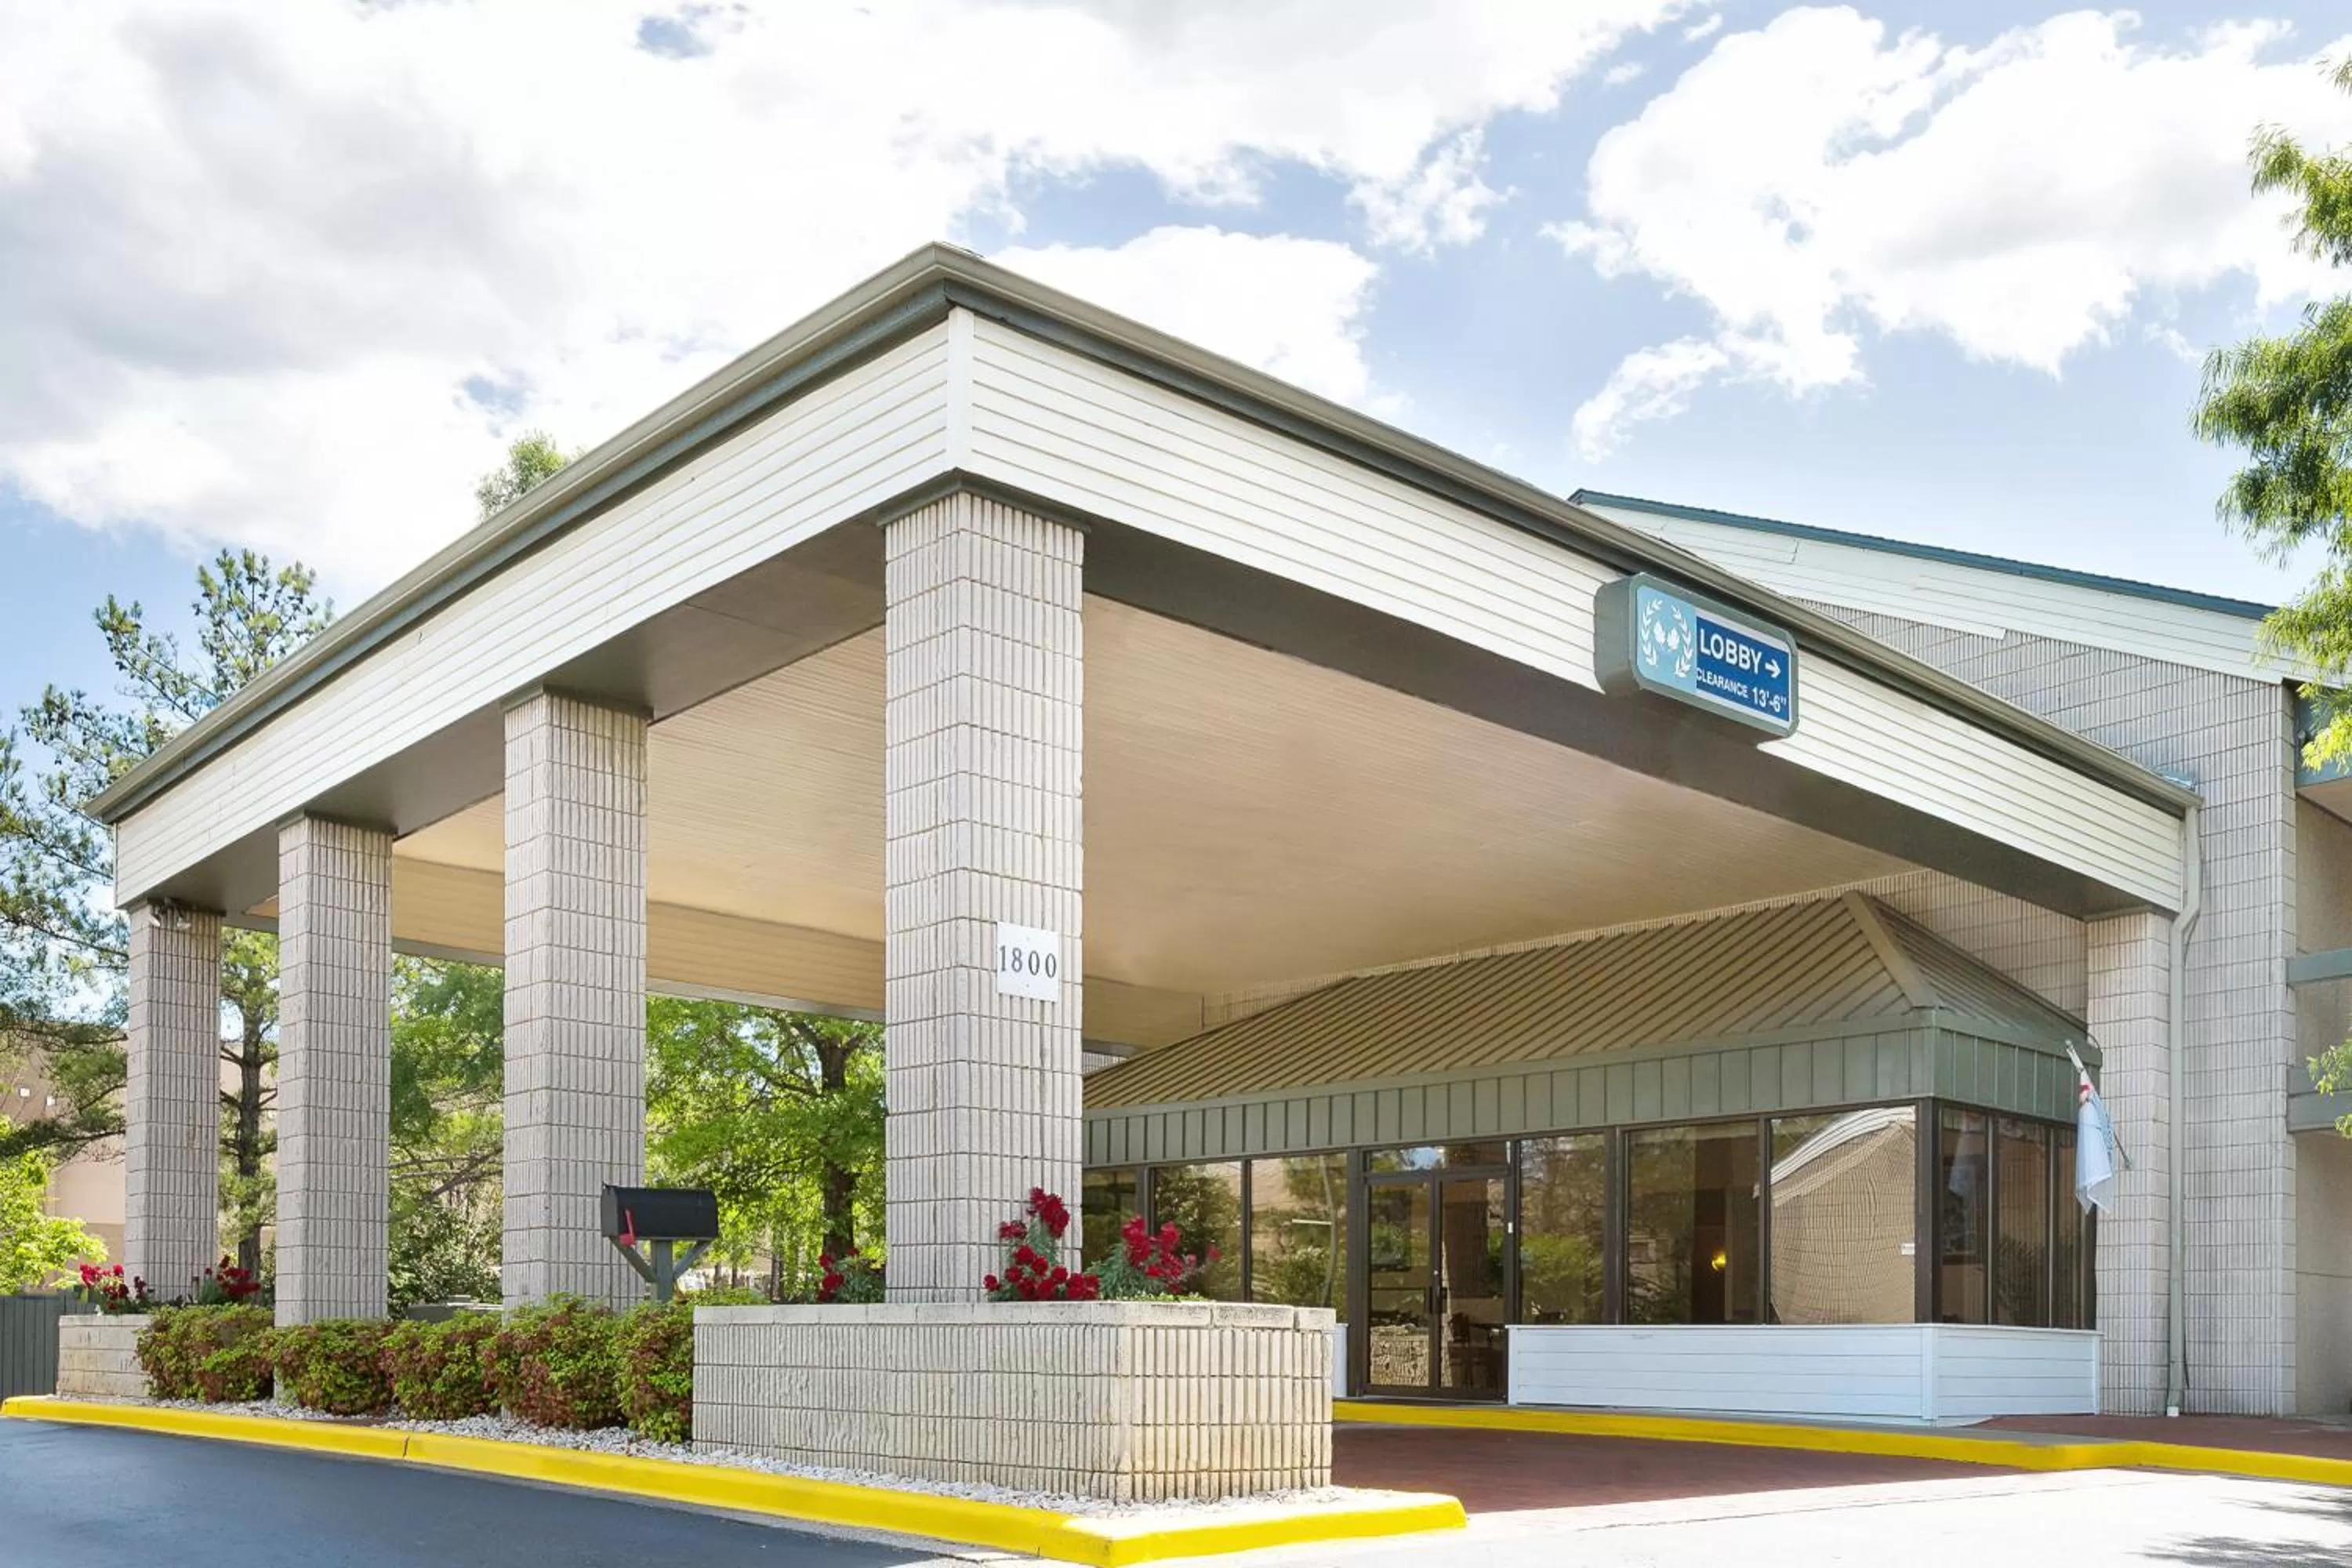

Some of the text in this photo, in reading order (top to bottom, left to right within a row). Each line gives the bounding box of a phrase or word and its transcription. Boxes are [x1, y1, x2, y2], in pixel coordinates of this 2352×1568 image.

[1700, 628, 1762, 675] LOBBY
[1697, 667, 1748, 699] CLEARANCE
[1000, 945, 1057, 978] 1800
